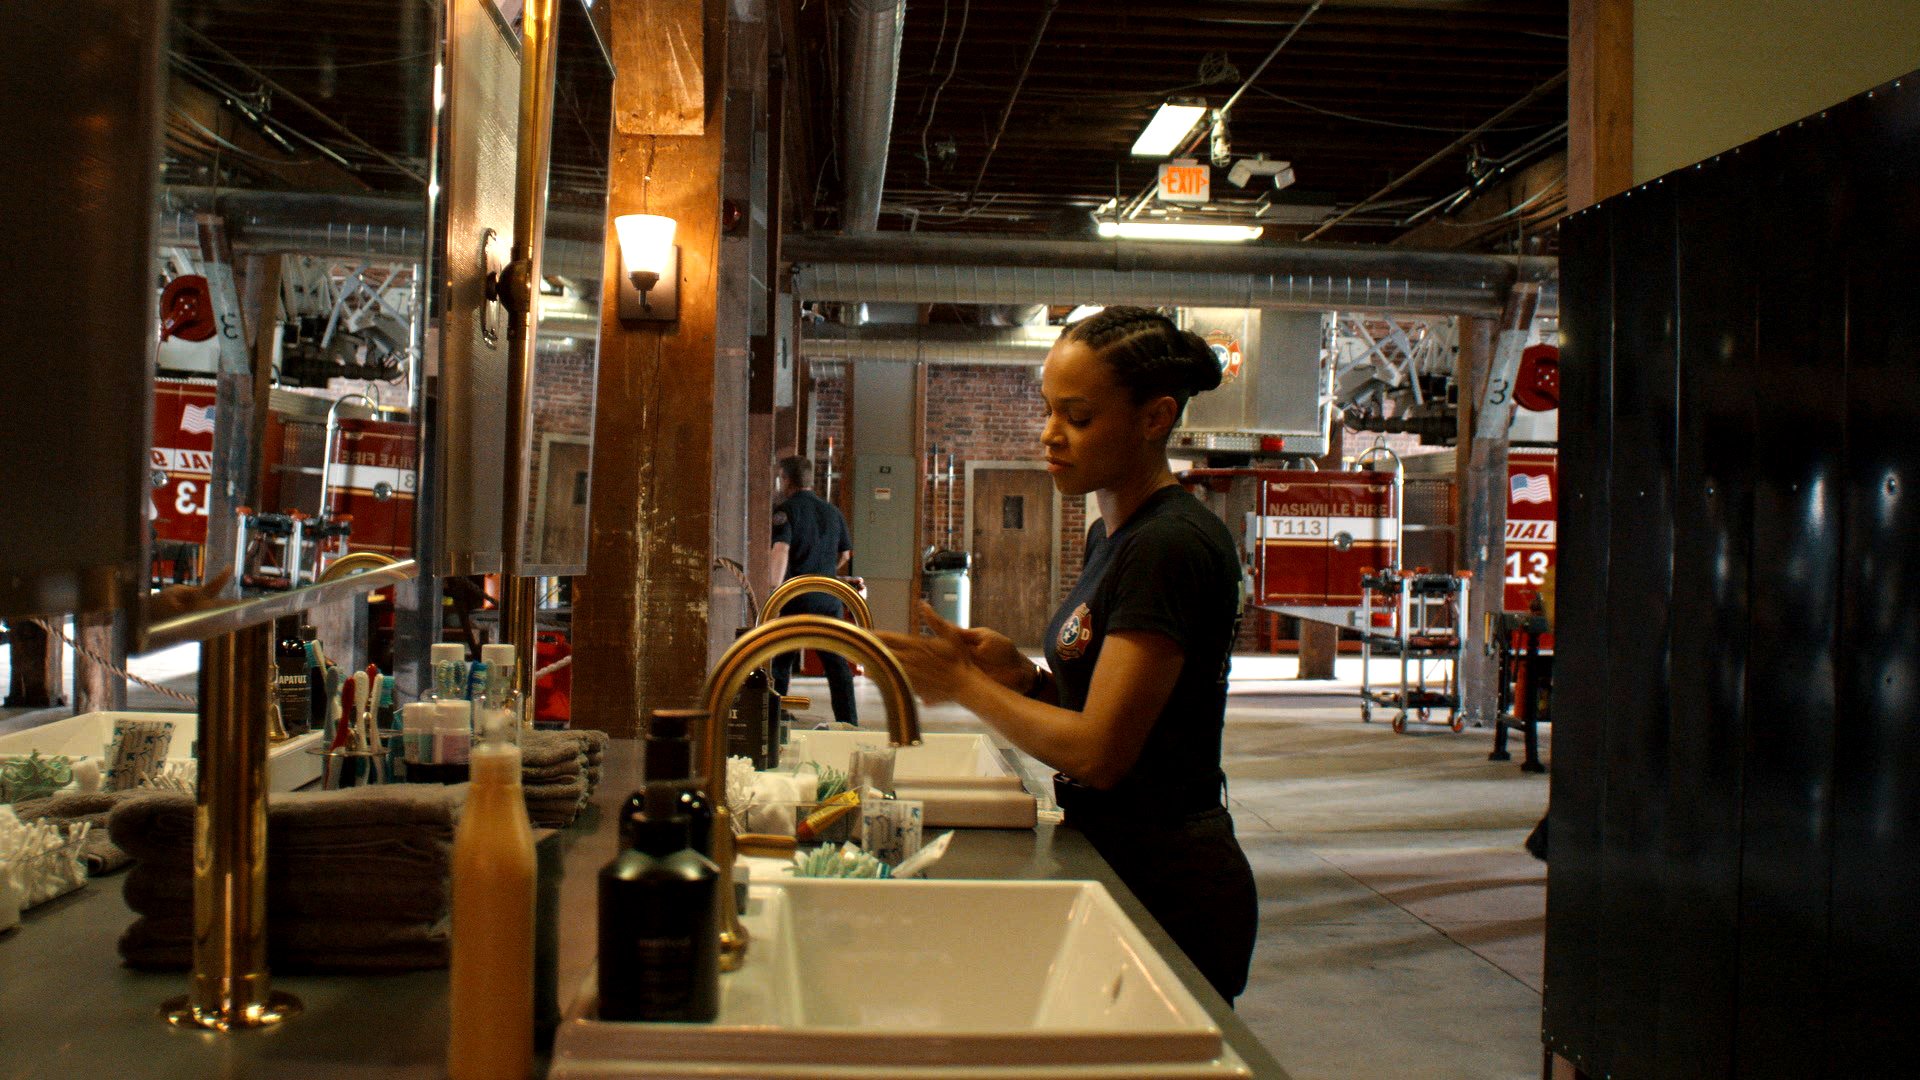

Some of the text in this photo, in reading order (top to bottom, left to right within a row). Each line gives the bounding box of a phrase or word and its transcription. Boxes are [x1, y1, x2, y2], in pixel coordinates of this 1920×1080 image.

[1167, 166, 1204, 195] EXIT
[1489, 378, 1509, 405] 3
[1269, 502, 1388, 517] NASHVILLE FIRE
[1272, 518, 1322, 537] T113
[1505, 550, 1549, 585] 13
